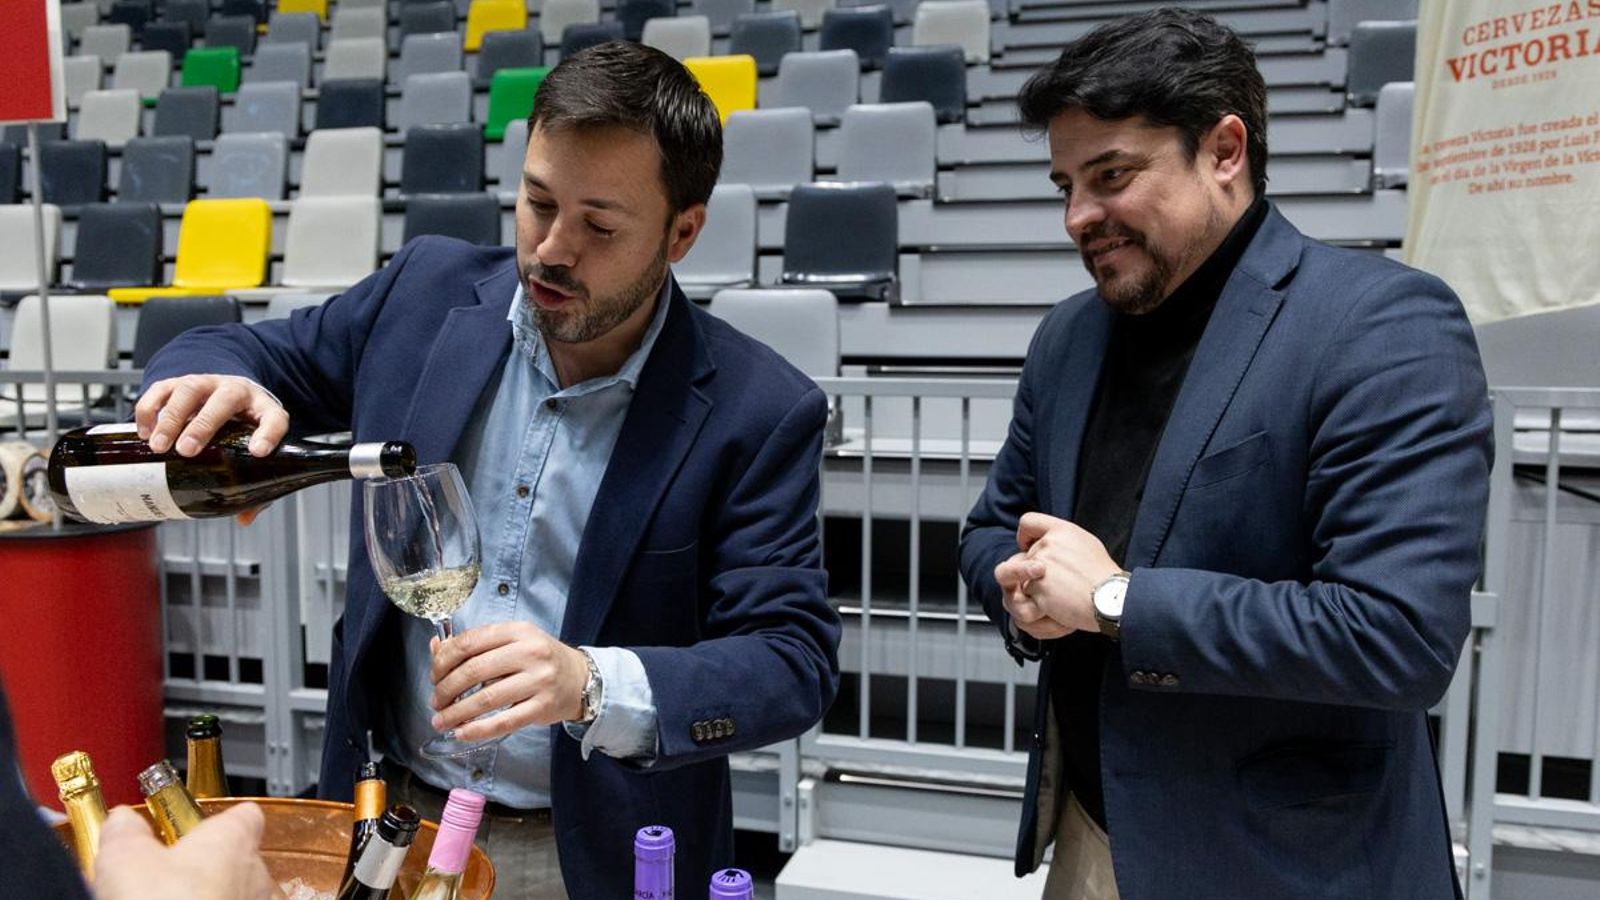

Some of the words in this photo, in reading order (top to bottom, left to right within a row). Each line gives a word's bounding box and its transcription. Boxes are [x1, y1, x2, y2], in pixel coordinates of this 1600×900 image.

[1463, 0, 1600, 46] CERVEZAS
[1471, 127, 1515, 142] Victoria
[1518, 122, 1537, 135] fue
[1541, 114, 1583, 132] creada
[1491, 144, 1505, 158] de
[1540, 138, 1561, 155] por
[1563, 134, 1589, 148] Luis
[1503, 159, 1542, 175] Virgen
[1544, 154, 1559, 168] de
[1562, 151, 1574, 166] la
